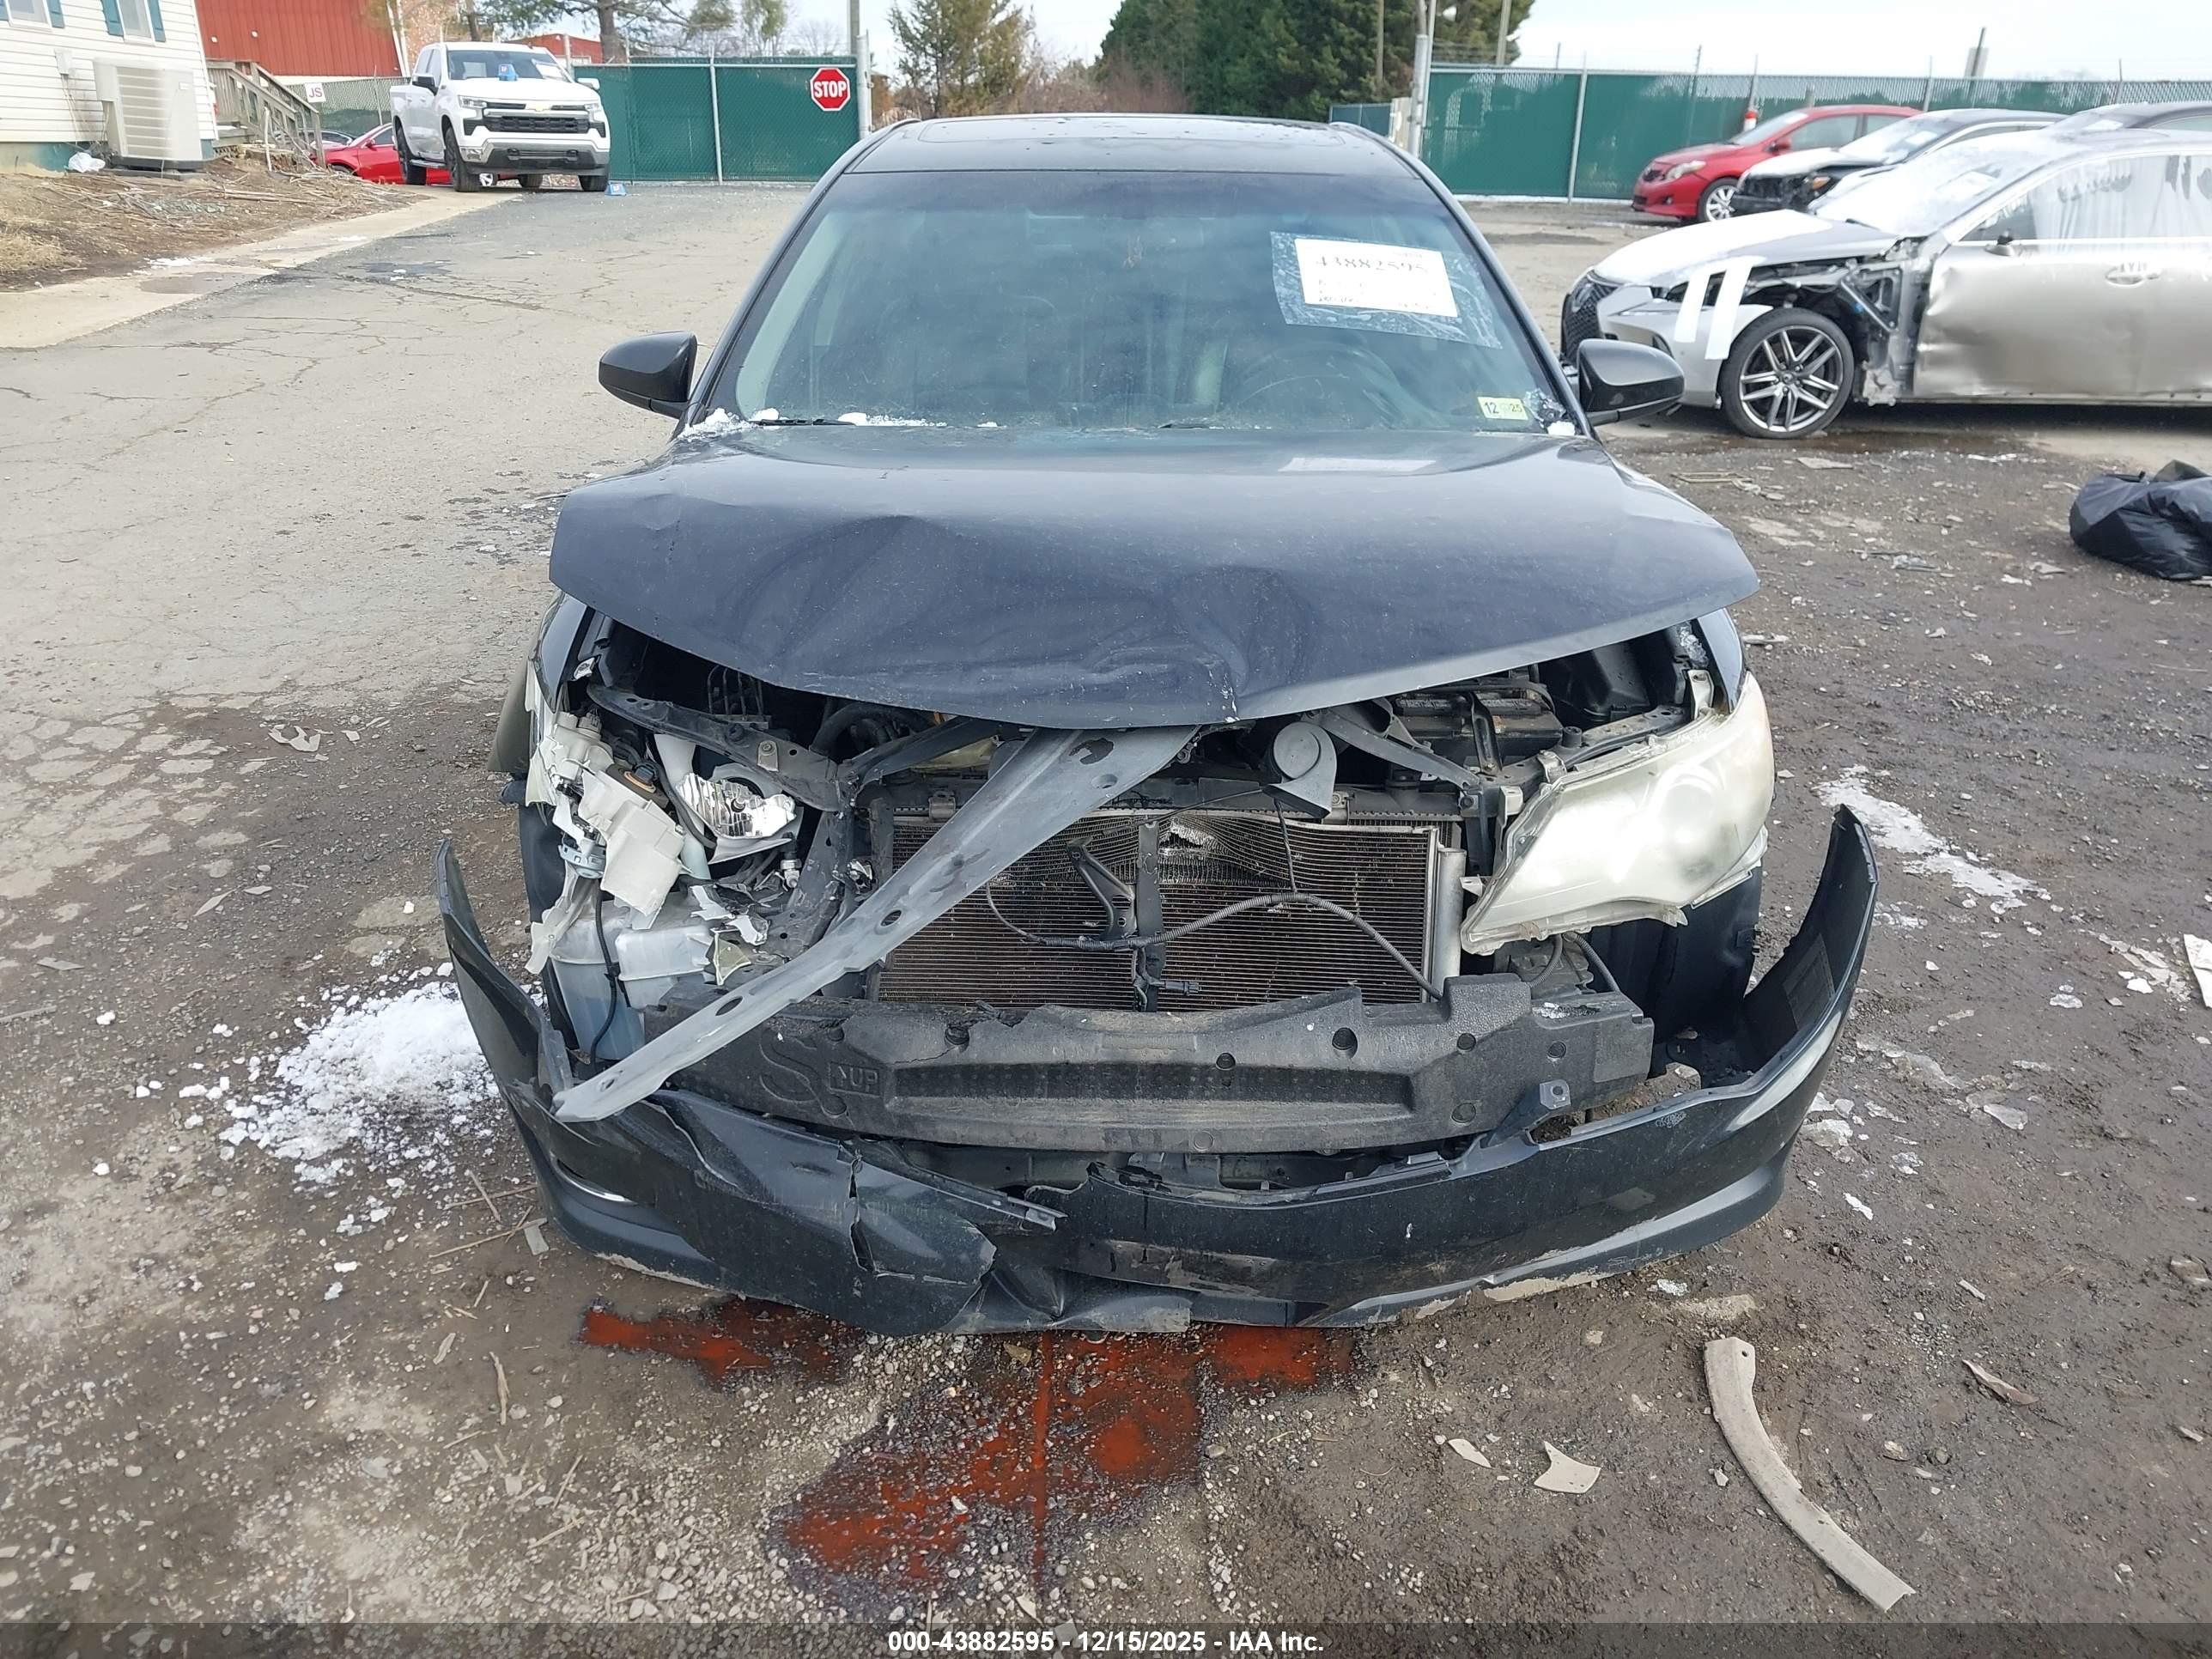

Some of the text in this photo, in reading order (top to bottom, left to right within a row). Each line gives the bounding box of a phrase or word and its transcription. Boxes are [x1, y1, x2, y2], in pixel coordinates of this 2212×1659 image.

[813, 80, 848, 99] STOP
[1484, 402, 1499, 414] 12
[850, 1067, 878, 1093] UP
